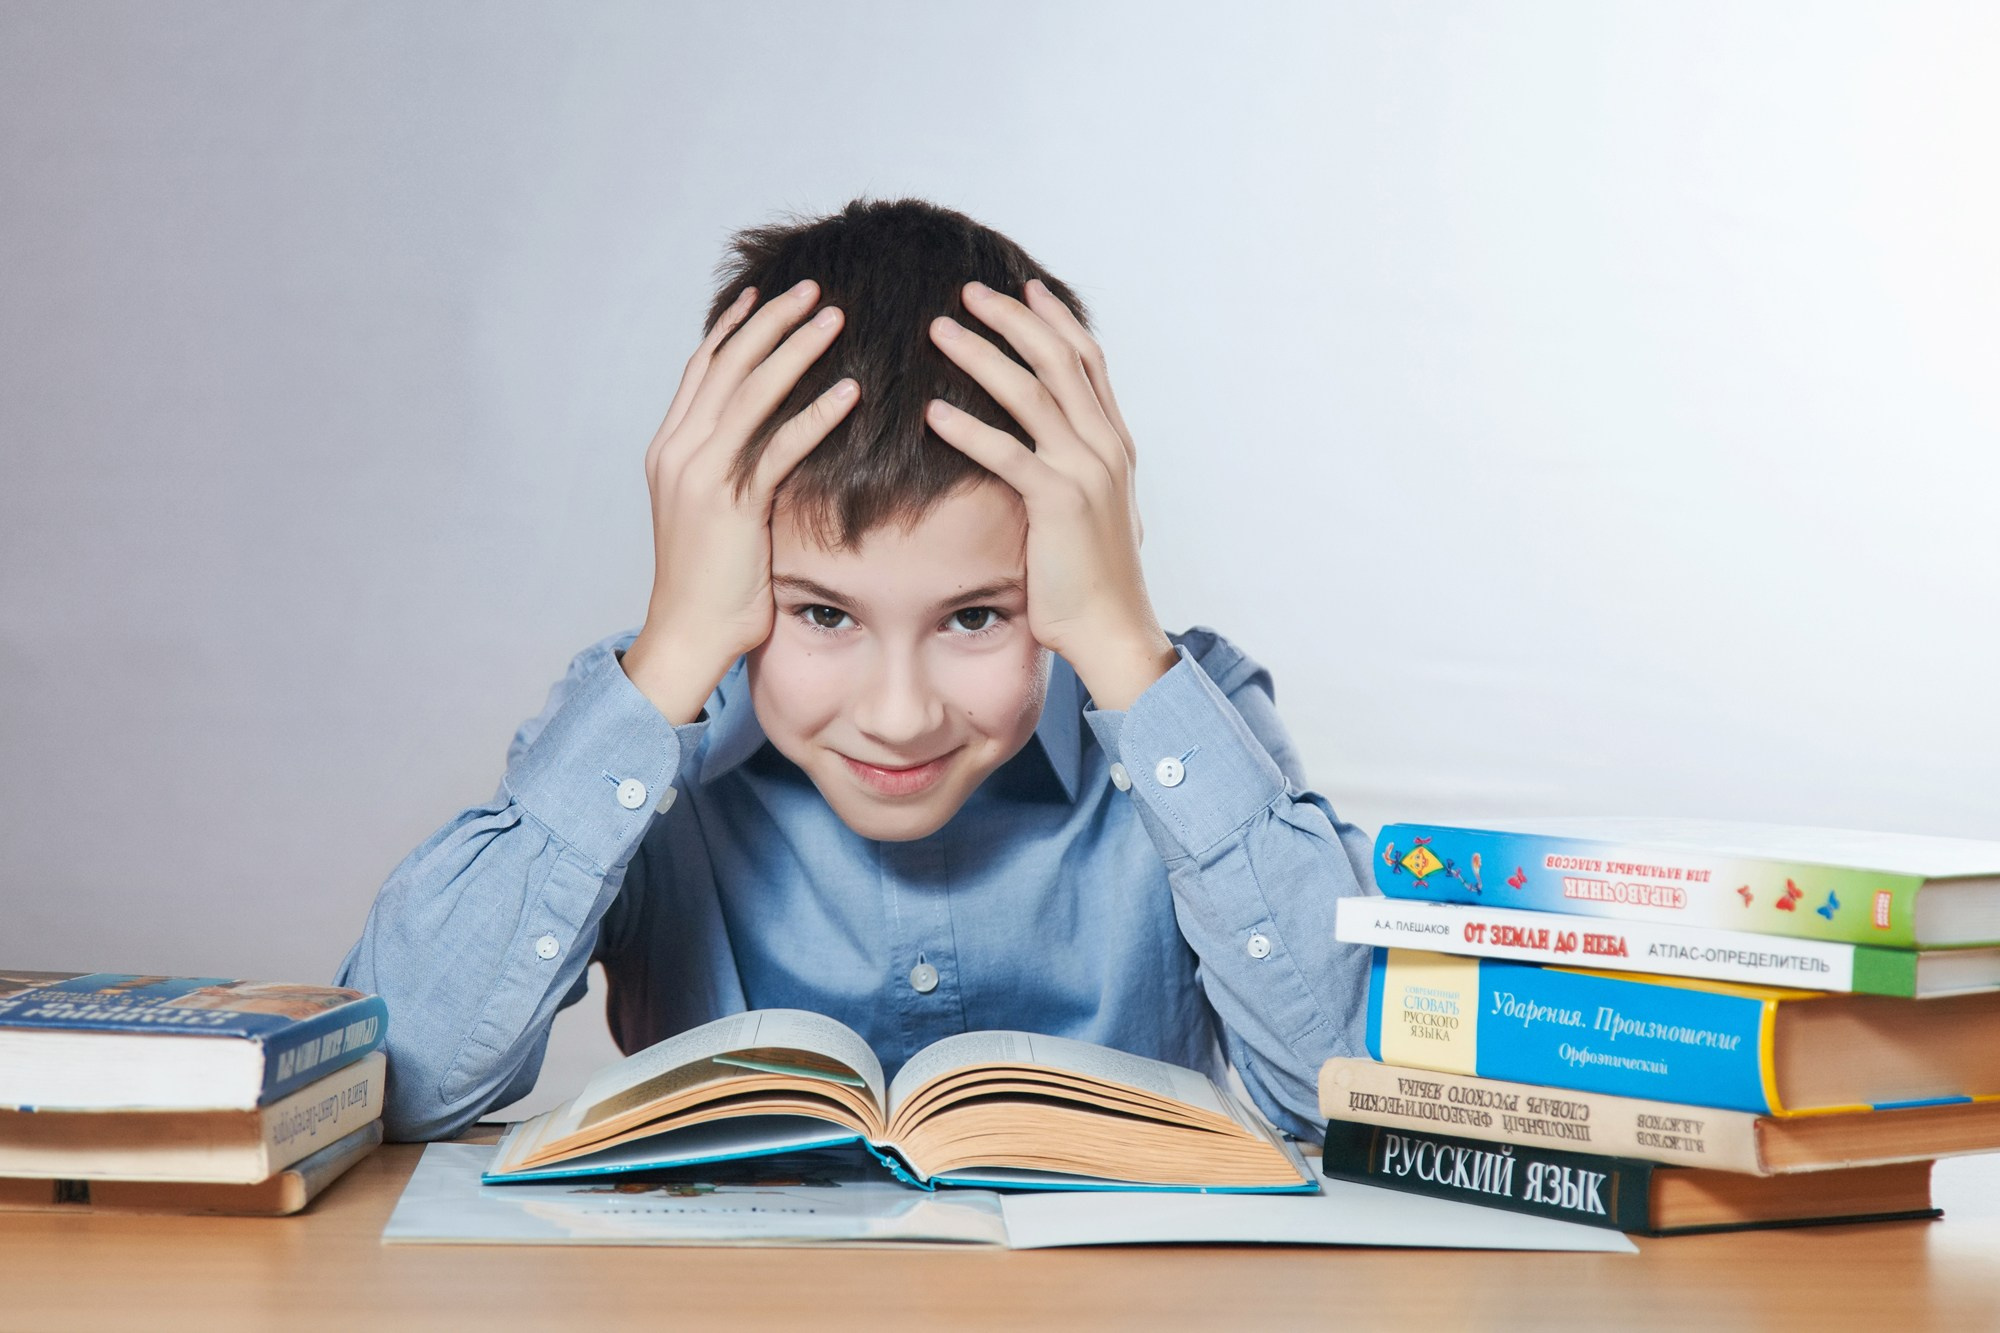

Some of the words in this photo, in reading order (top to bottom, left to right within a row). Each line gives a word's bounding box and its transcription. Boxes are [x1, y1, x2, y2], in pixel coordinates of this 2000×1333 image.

[1546, 855, 1602, 873] КЛАССОВ
[1606, 861, 1682, 880] НАЧАЛЬНЫХ
[1686, 868, 1712, 883] ДЛЯ
[1563, 876, 1687, 909] СПРАВОЧНИК
[1396, 920, 1450, 936] ПЛЕШАКОВ
[1464, 922, 1487, 944] ОТ
[1490, 925, 1551, 951] ЗЕМЛИ
[1553, 931, 1579, 954] ДО
[1582, 933, 1629, 958] НЕБА
[1648, 943, 1831, 973] АТЛАС-ОПРЕДЕЛИТЕЛЬ
[1403, 994, 1460, 1016] СЛОВАРЬ
[1403, 1010, 1459, 1030] РУССКОГО
[1491, 991, 1587, 1029] Ударения.
[1593, 1006, 1742, 1052] Произношение
[1410, 1025, 1451, 1042] ЯЗЫКА
[1558, 1042, 1669, 1075] Орфоэпический
[340, 1090, 346, 1111] о
[347, 1079, 369, 1109] Книга
[1397, 1077, 1444, 1100] ЯЗЫКА
[1448, 1086, 1521, 1112] РУССКОГО
[1348, 1091, 1493, 1128] ФРАЗЕОЛОГИЧЕСКИЙ
[1527, 1100, 1590, 1122] СЛОВАРЬ
[1502, 1114, 1592, 1142] ШКОЛЬНЫЙ
[1382, 1133, 1517, 1198] РУССКИЙ
[1523, 1161, 1607, 1216] ЯЗЫК
